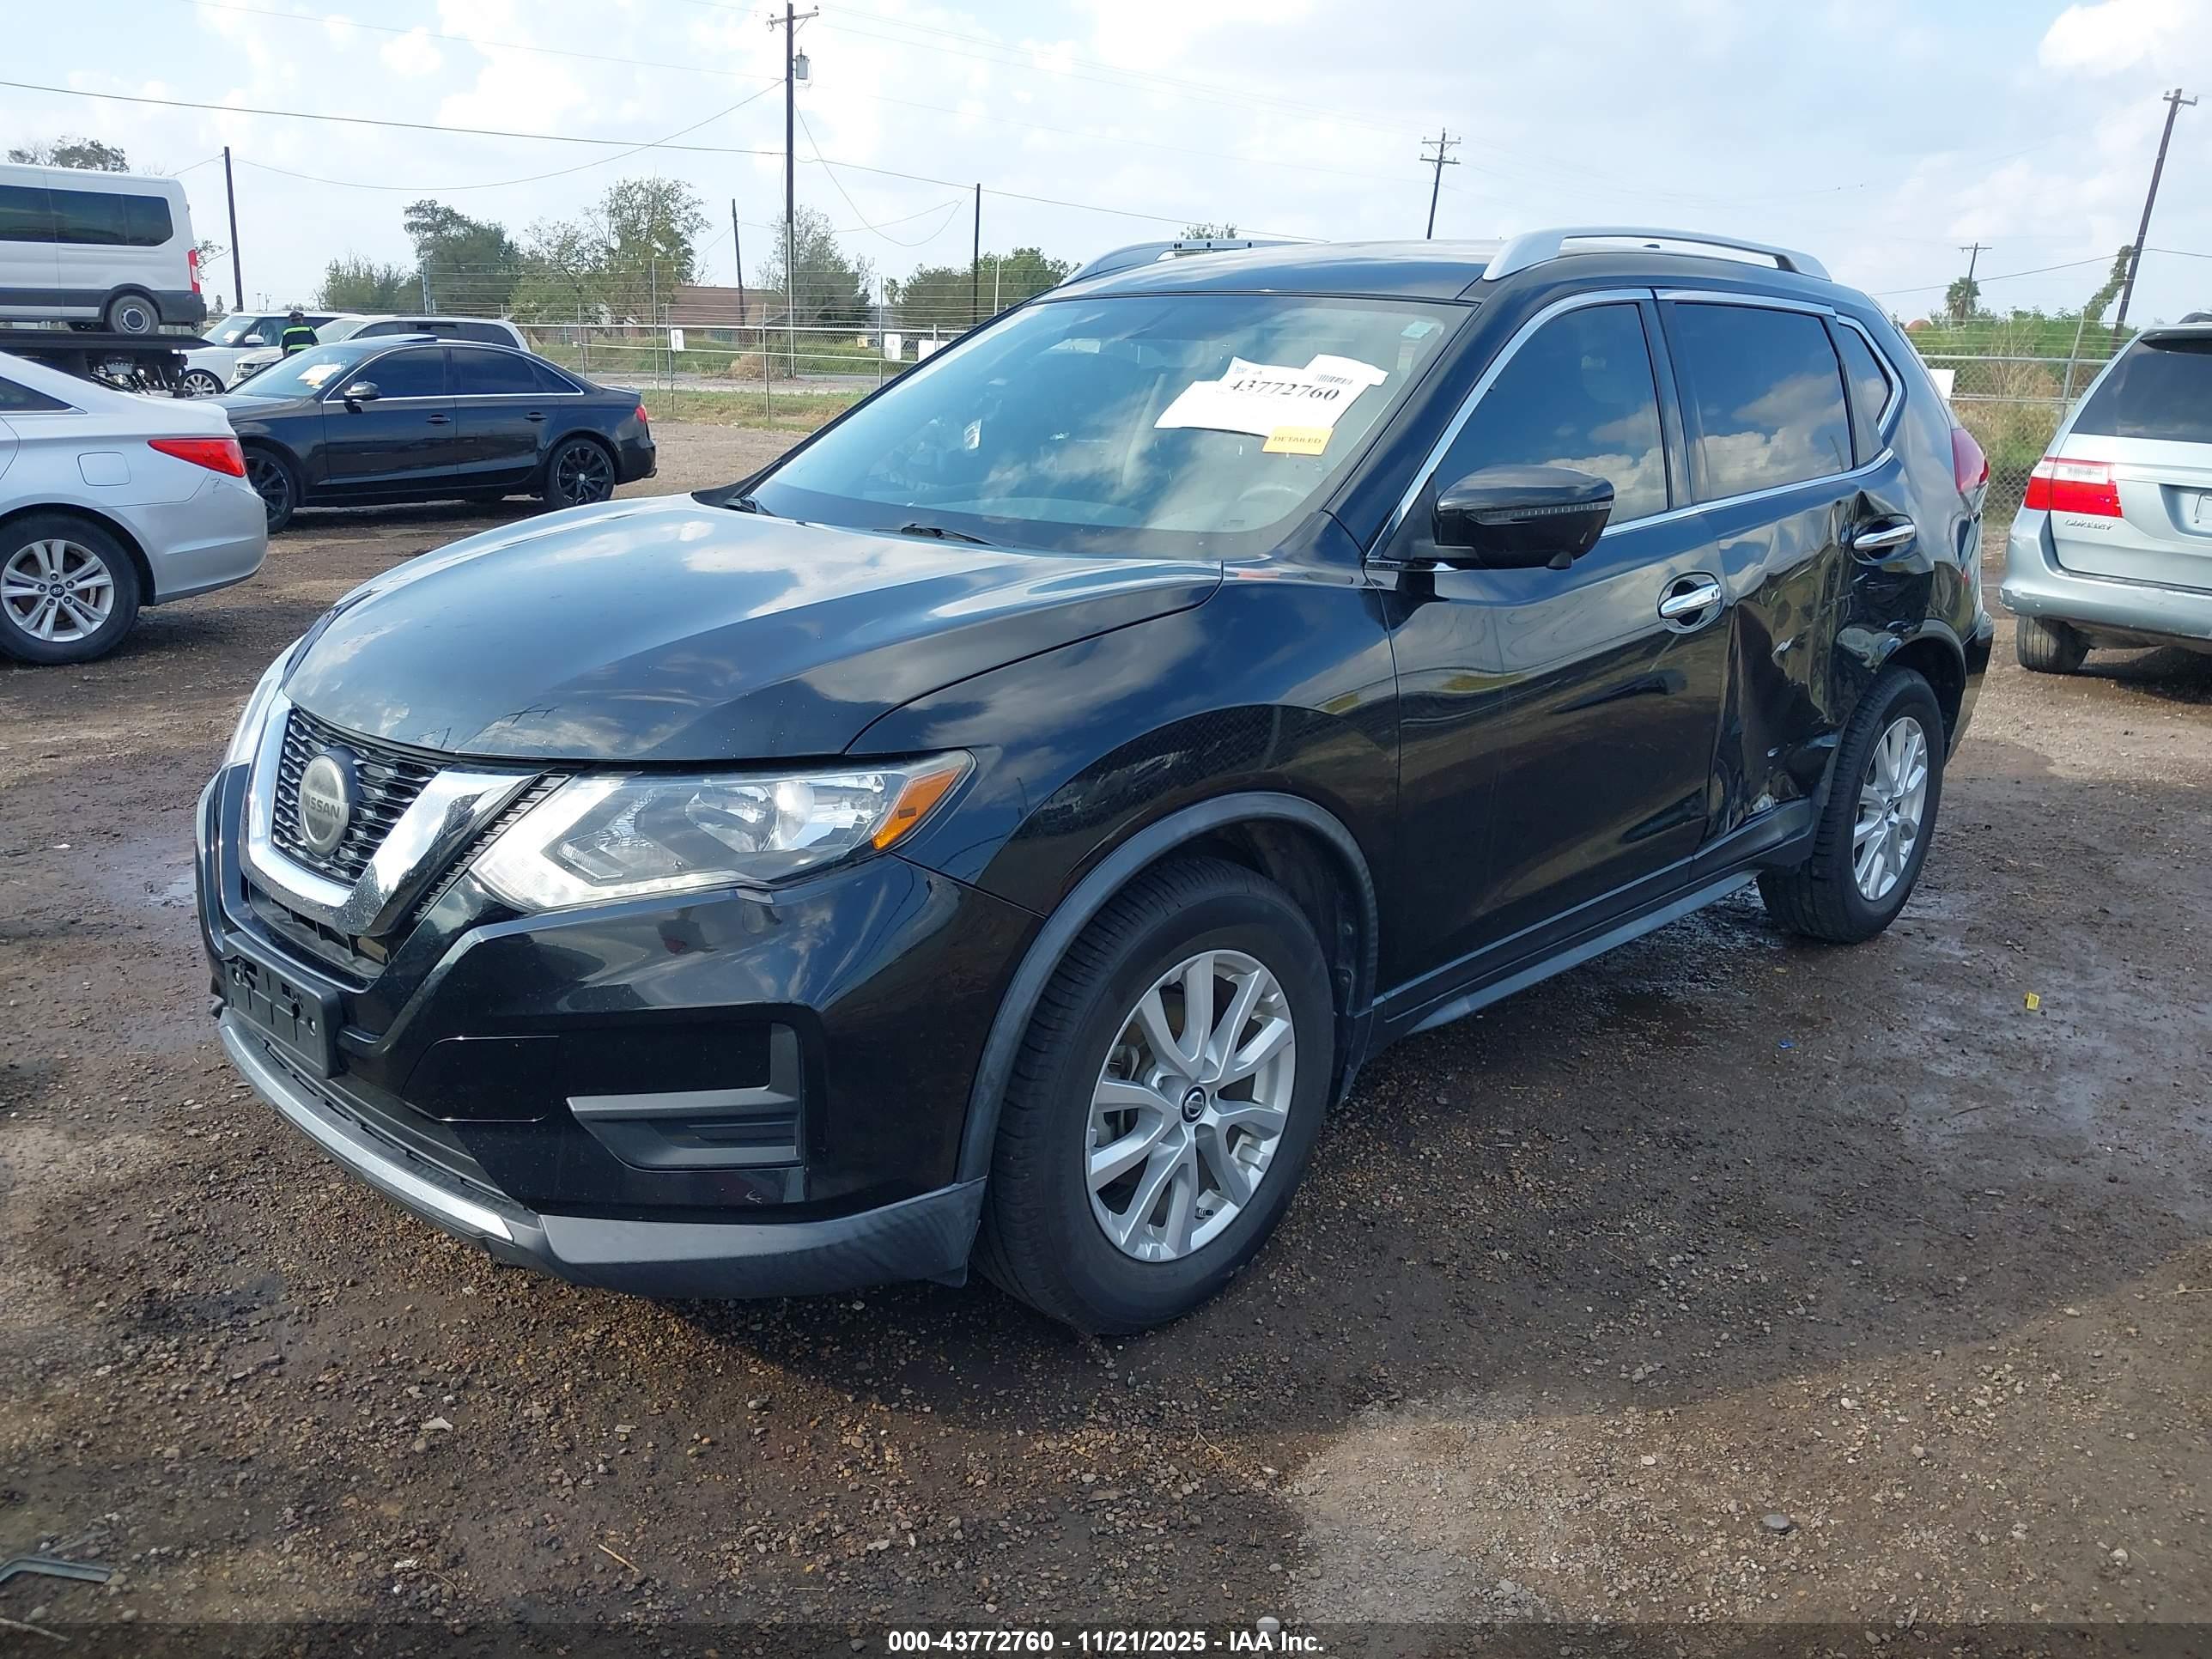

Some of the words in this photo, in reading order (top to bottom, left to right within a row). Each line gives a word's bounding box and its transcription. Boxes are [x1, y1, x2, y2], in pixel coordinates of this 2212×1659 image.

[1230, 380, 1340, 400] 43772760
[2065, 519, 2115, 530] ODYSSEY
[304, 793, 340, 818] NISSAN
